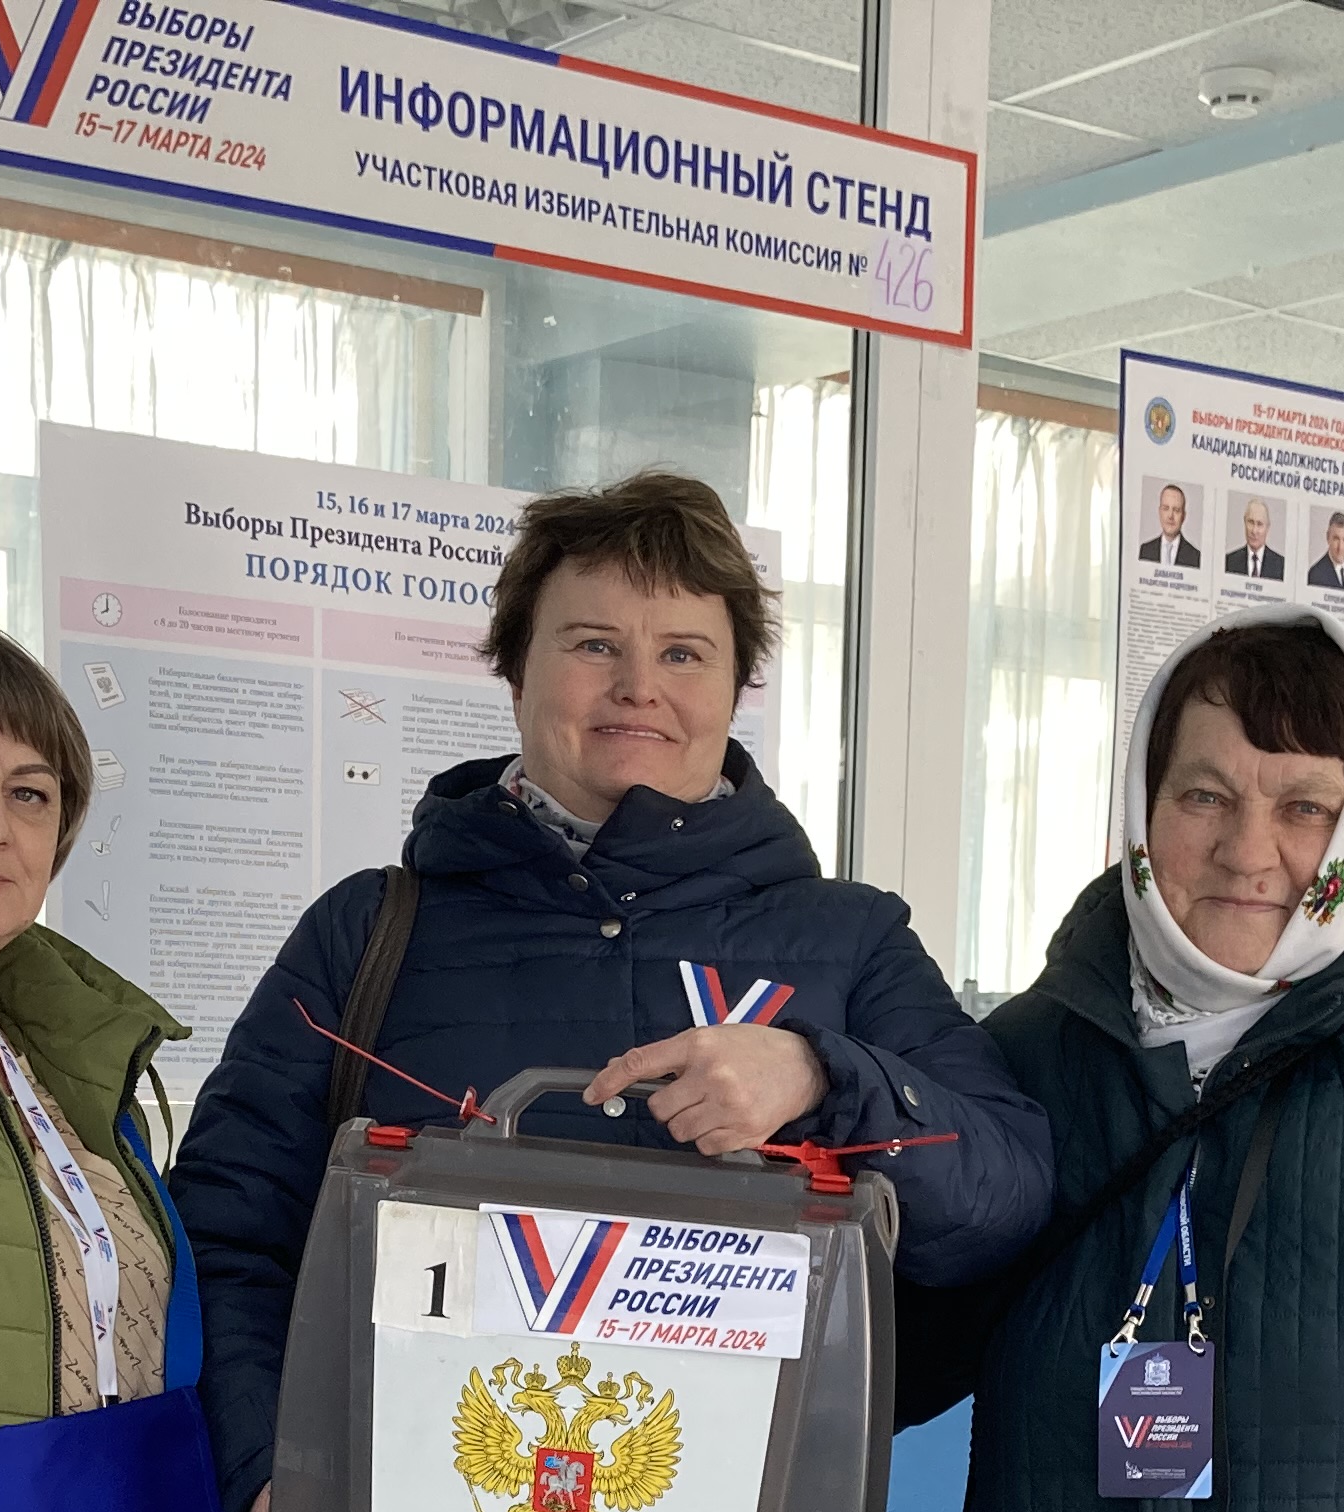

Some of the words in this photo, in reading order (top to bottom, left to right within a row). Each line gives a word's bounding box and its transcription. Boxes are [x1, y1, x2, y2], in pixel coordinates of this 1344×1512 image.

[117, 0, 255, 52] ВЫБОРЫ
[102, 36, 292, 102] ПРЕЗИДЕНТА
[86, 74, 212, 125] РОССИИ
[138, 124, 210, 160] МАРТА
[216, 140, 268, 172] 2024
[339, 64, 792, 209] ИНФОРМАЦИОННЫЙ
[806, 170, 933, 241] СТЕНД
[356, 150, 518, 208] УЧАСТКОВАЯ
[524, 188, 719, 248] ИЗБИРАТЕЛЬНАЯ
[725, 230, 842, 274] КОМИССИЯ
[874, 238, 935, 312] 426
[1192, 410, 1234, 430] ВЫБОРЫ
[1277, 409, 1306, 427] МАРТА
[1191, 434, 1257, 461] КАНДИДАТЫ
[1260, 447, 1274, 463] НА
[1275, 449, 1339, 475] ДОЛЖНОСТЬ
[1231, 461, 1300, 489] РОССИЙСКОЙ
[184, 502, 283, 539] Выборы
[290, 517, 422, 556] Президента
[316, 490, 342, 514] 15,
[349, 495, 369, 516] 16
[374, 505, 385, 518] и
[391, 501, 412, 521] 17
[416, 509, 470, 532] марта
[475, 514, 516, 536] 2024
[245, 553, 392, 596] ПОРЯДОК
[639, 1224, 763, 1257] ВЫБОРЫ
[420, 1260, 451, 1319] 1
[624, 1258, 797, 1293] ПРЕЗИДЕНТА
[608, 1288, 720, 1319] РОССИИ
[650, 1324, 716, 1347] МАРТА
[719, 1328, 767, 1351] 2024
